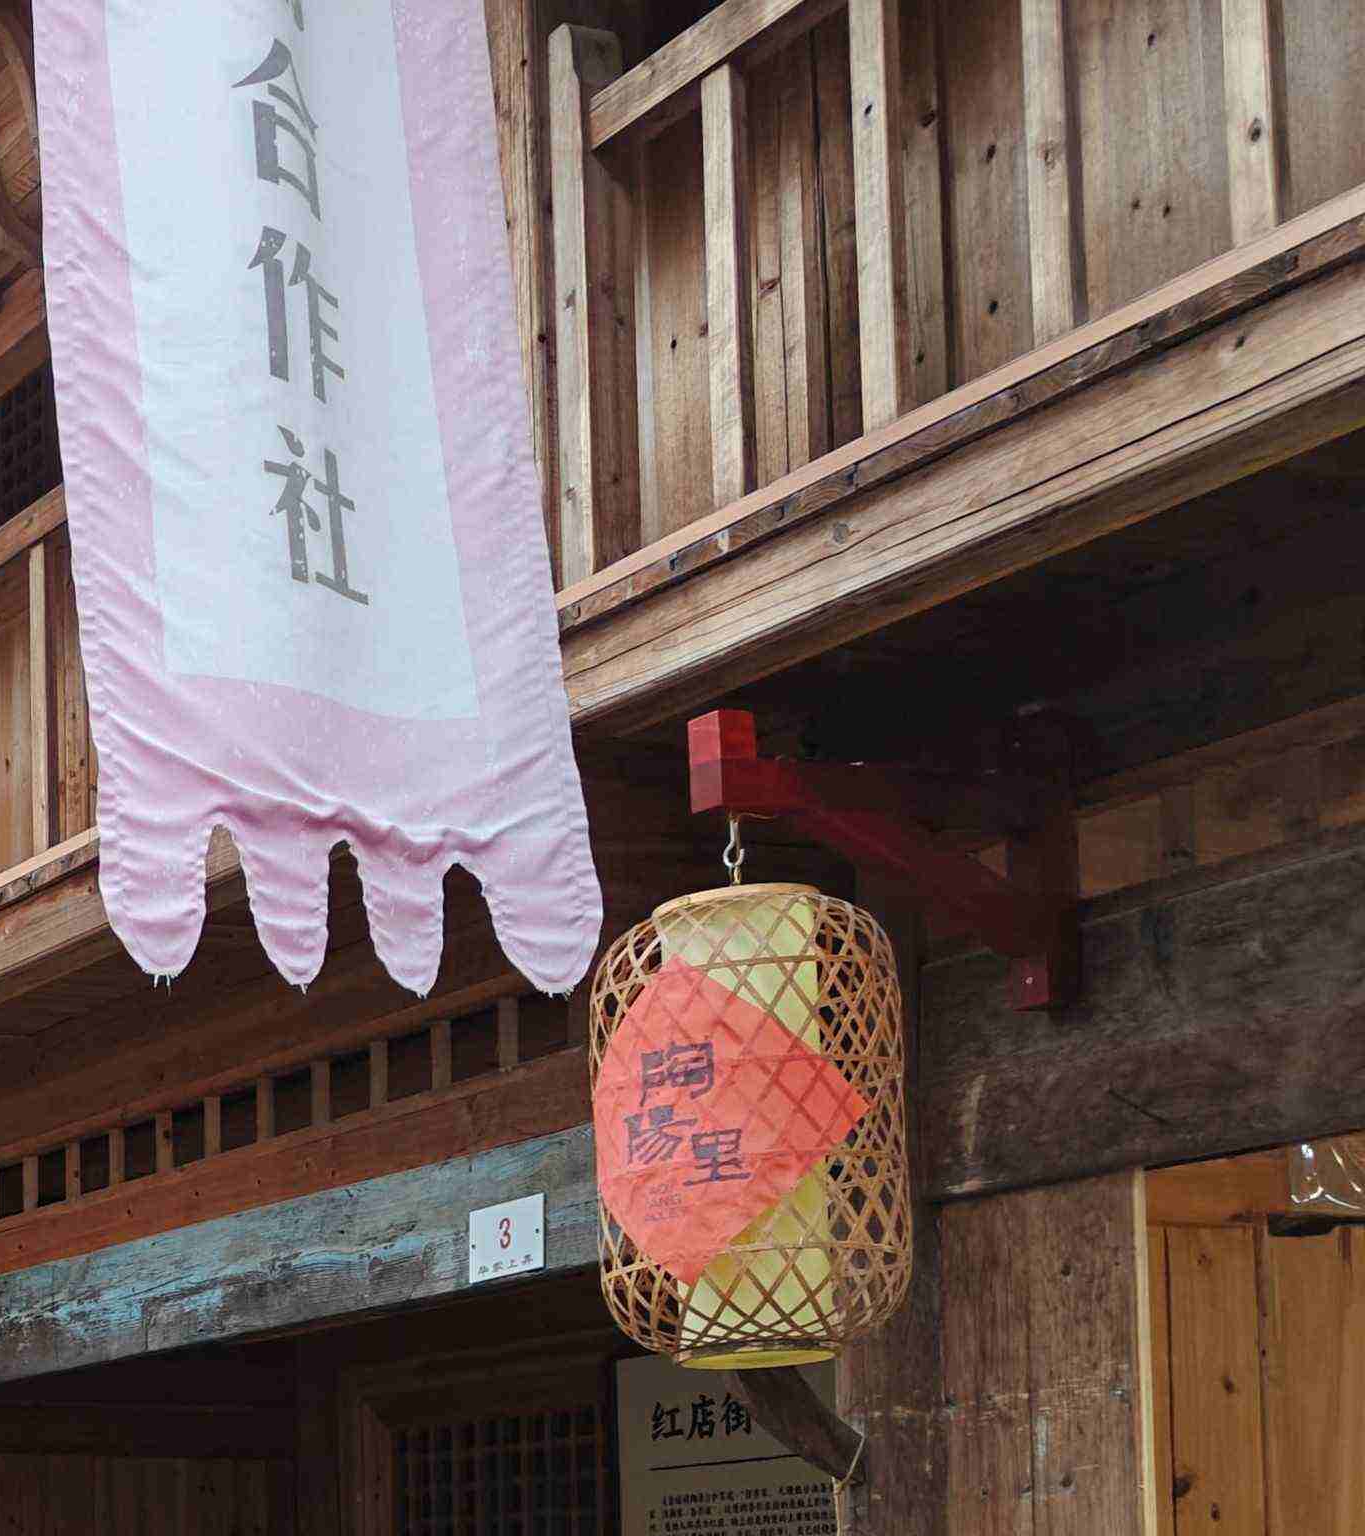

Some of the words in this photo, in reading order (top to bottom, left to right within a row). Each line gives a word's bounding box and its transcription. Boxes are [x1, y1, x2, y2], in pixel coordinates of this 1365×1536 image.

[232, 0, 369, 606] 合作社
[498, 1217, 512, 1250] 3
